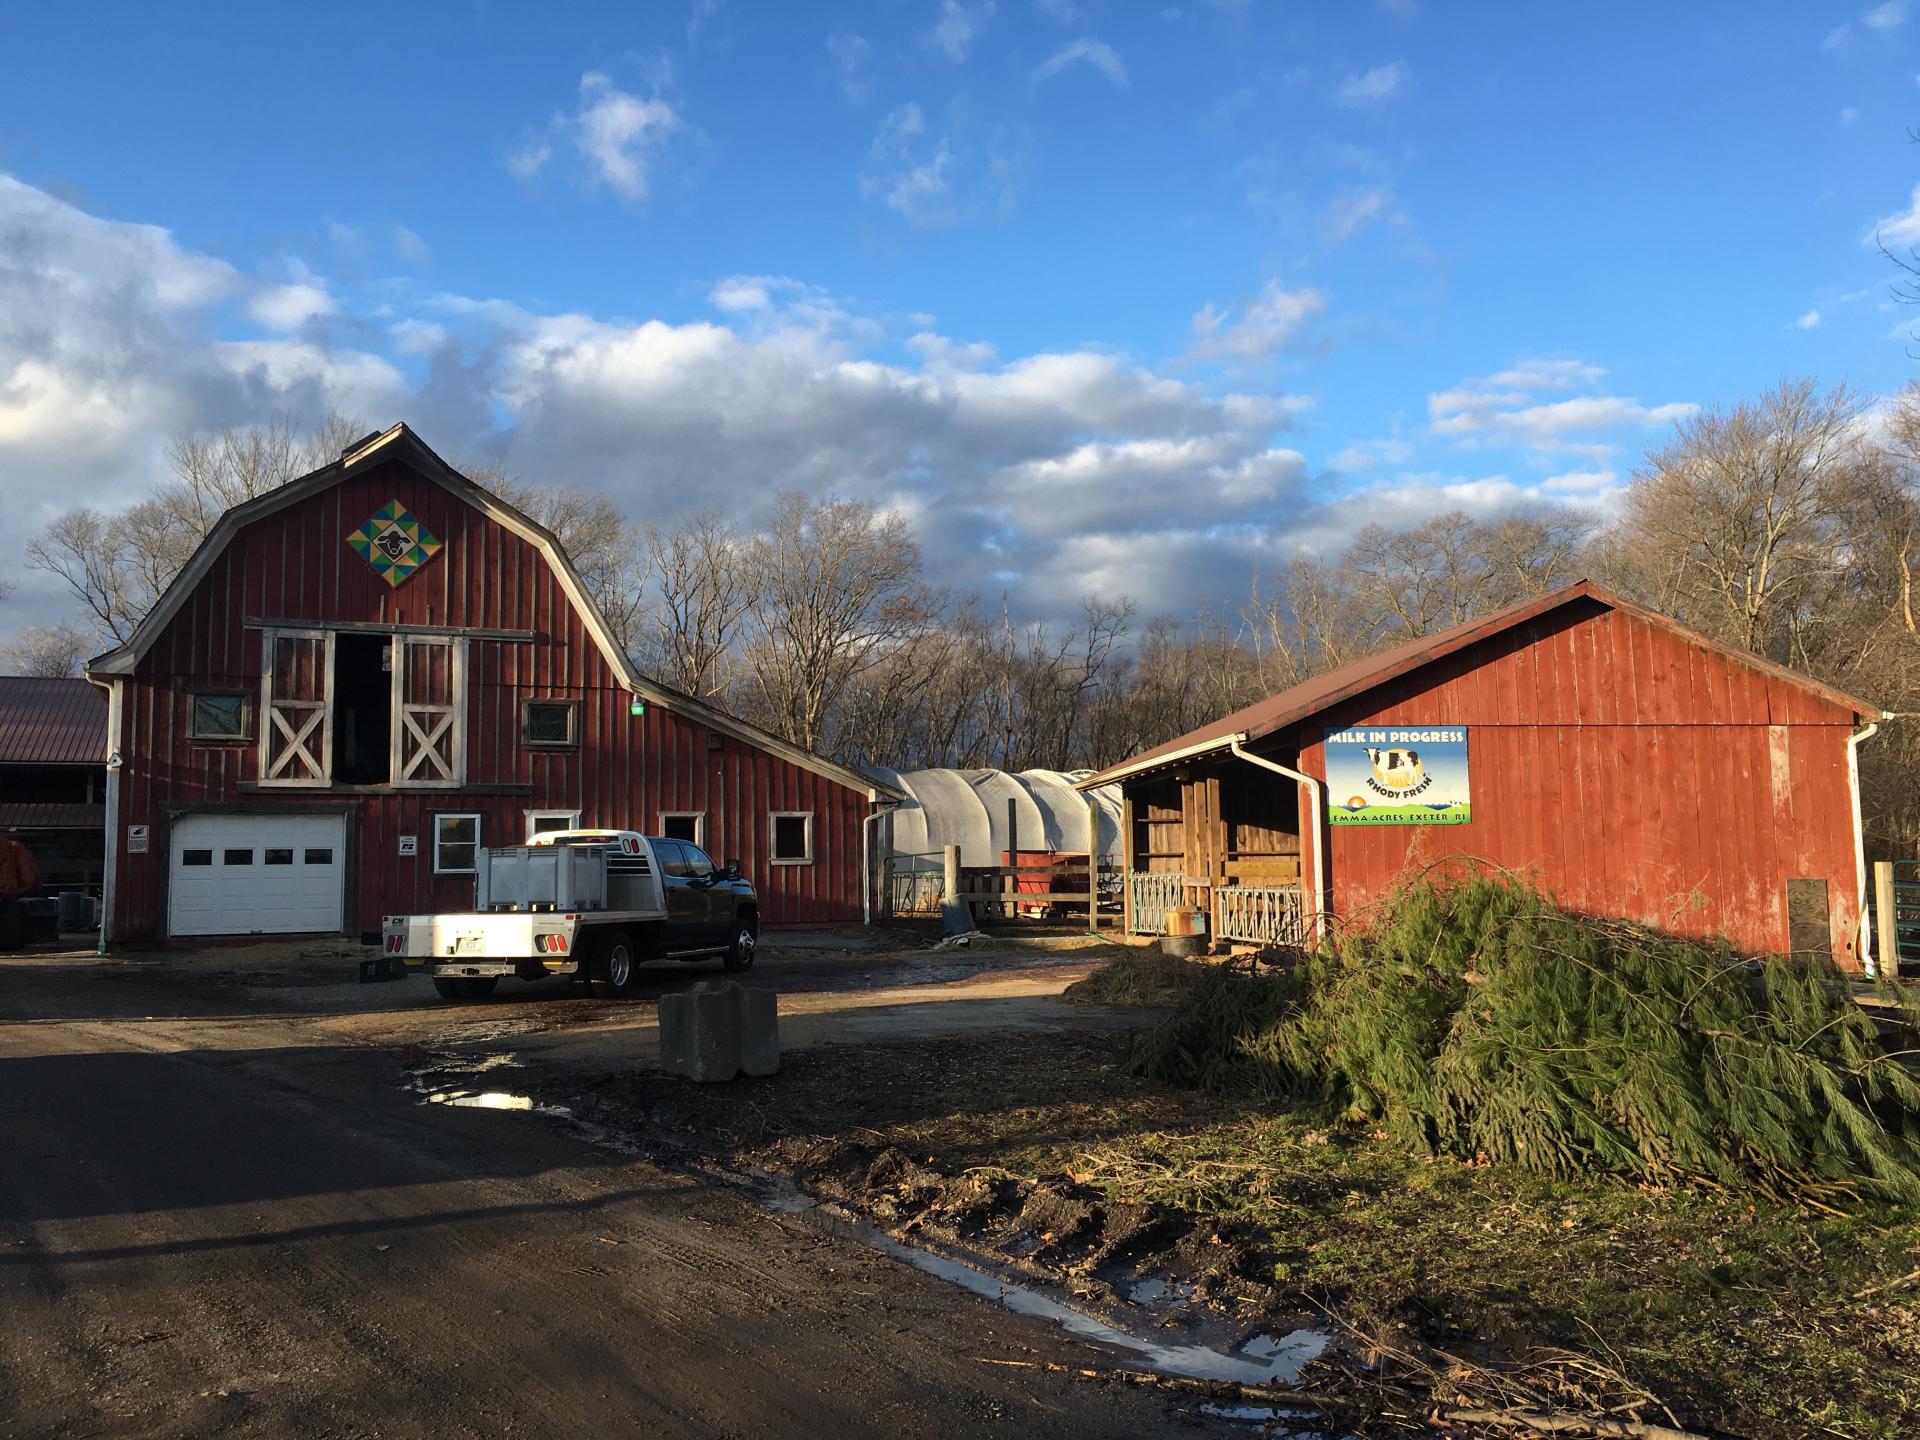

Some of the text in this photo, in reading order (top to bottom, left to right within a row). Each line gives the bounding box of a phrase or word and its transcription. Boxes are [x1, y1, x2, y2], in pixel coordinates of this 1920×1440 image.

[1328, 731, 1464, 743] MILK IN PROGRESS
[1366, 772, 1433, 799] RHODY FRESH
[1333, 814, 1368, 822] EMMA
[1410, 813, 1448, 821] EXETER
[1455, 813, 1465, 821] RI
